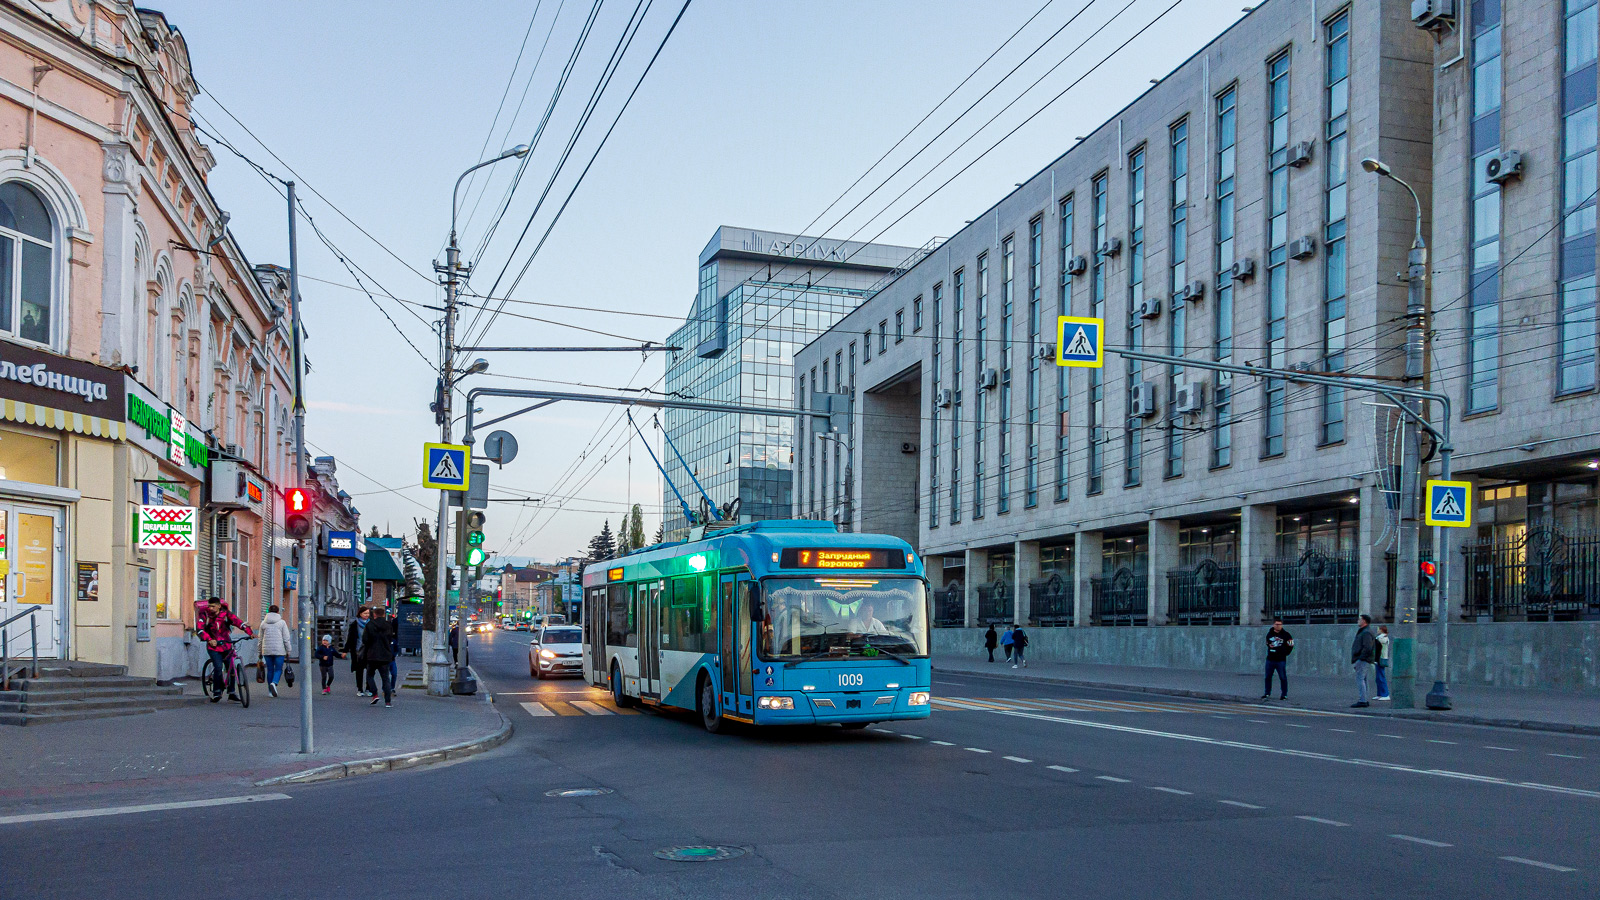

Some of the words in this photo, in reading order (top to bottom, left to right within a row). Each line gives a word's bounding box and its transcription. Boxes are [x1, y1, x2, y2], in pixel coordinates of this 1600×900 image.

[768, 239, 848, 261] АТРИУМ
[802, 551, 810, 564] 7
[818, 551, 872, 561] Запрудный
[818, 560, 865, 568] Аэропорт
[838, 673, 863, 686] 1009
